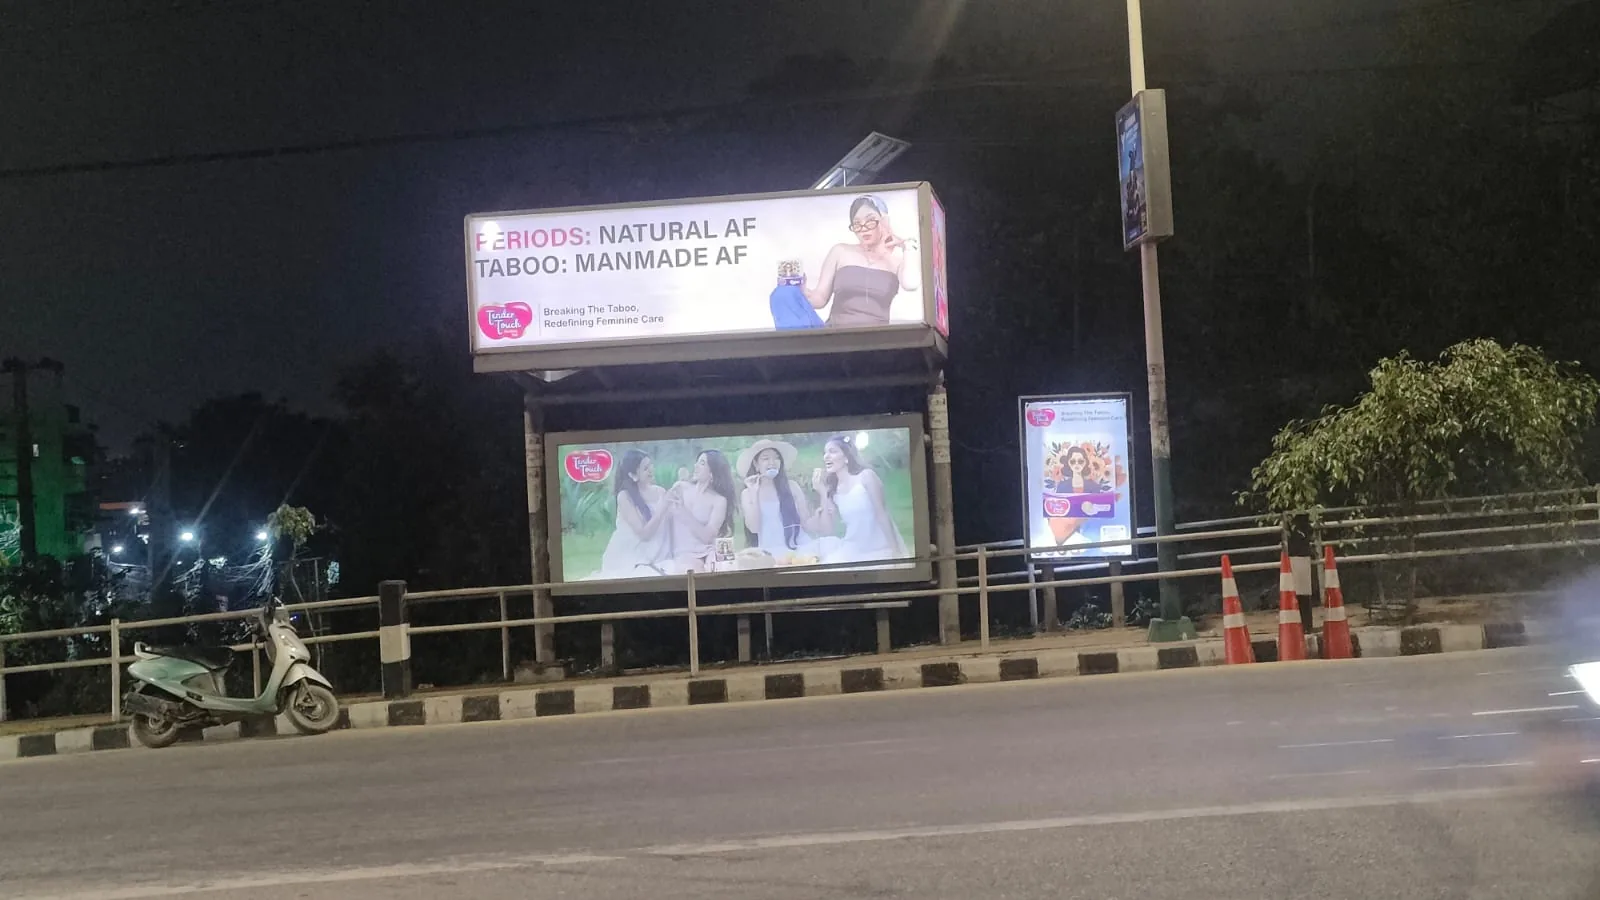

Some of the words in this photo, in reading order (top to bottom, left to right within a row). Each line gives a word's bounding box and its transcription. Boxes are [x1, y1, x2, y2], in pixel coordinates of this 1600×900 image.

[475, 227, 591, 251] PERIODS:
[599, 220, 718, 244] NATURAL
[724, 217, 756, 238] AF
[474, 255, 567, 278] TABOO:
[575, 247, 708, 273] MANMADE
[715, 245, 748, 266] AF
[485, 309, 515, 325] Tender
[543, 307, 585, 317] Breaking
[587, 304, 605, 314] The
[607, 304, 640, 313] Taboo,
[494, 319, 521, 335] Touch
[544, 318, 594, 328] Redefining
[596, 315, 639, 326] Feminine
[641, 314, 664, 324] Care
